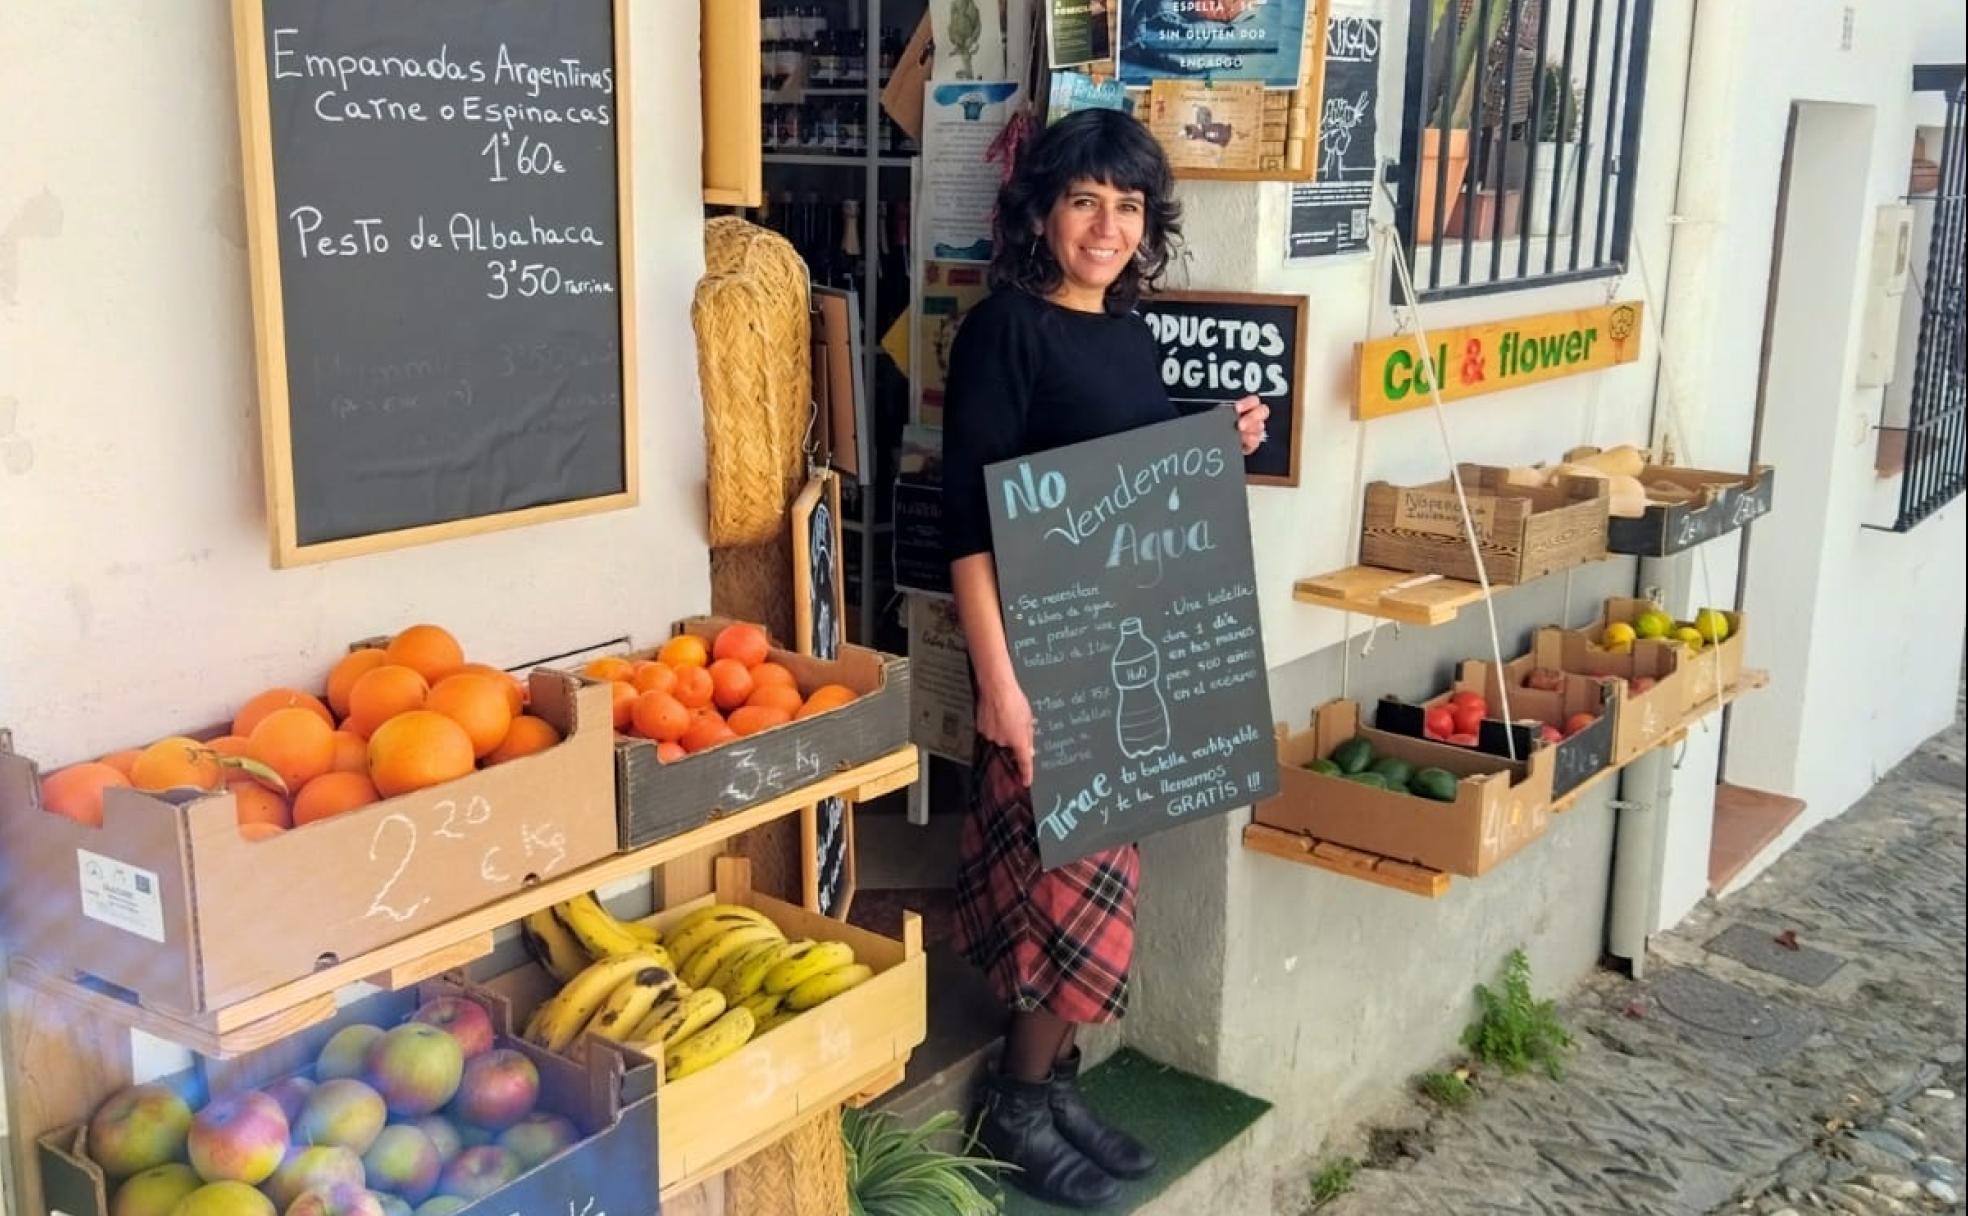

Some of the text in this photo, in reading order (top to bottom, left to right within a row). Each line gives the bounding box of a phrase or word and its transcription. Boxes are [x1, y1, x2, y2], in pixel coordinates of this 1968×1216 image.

[1159, 28, 1266, 40] SIN GLUTEN POR
[1173, 1, 1224, 13] ESPELTA
[274, 28, 486, 92] Empanadas
[1180, 56, 1244, 70] ENCARGO
[315, 90, 609, 130] Carne o Espinacas
[410, 215, 442, 250] de
[1383, 328, 1598, 401] Col & flower
[1002, 461, 1067, 519] No
[1043, 447, 1225, 546] Vendemos
[1104, 519, 1218, 589] Agua
[1037, 772, 1112, 841] Trae
[1120, 765, 1137, 785] tu
[1140, 752, 1188, 777] botella
[1099, 764, 1227, 825] y te la llenamos
